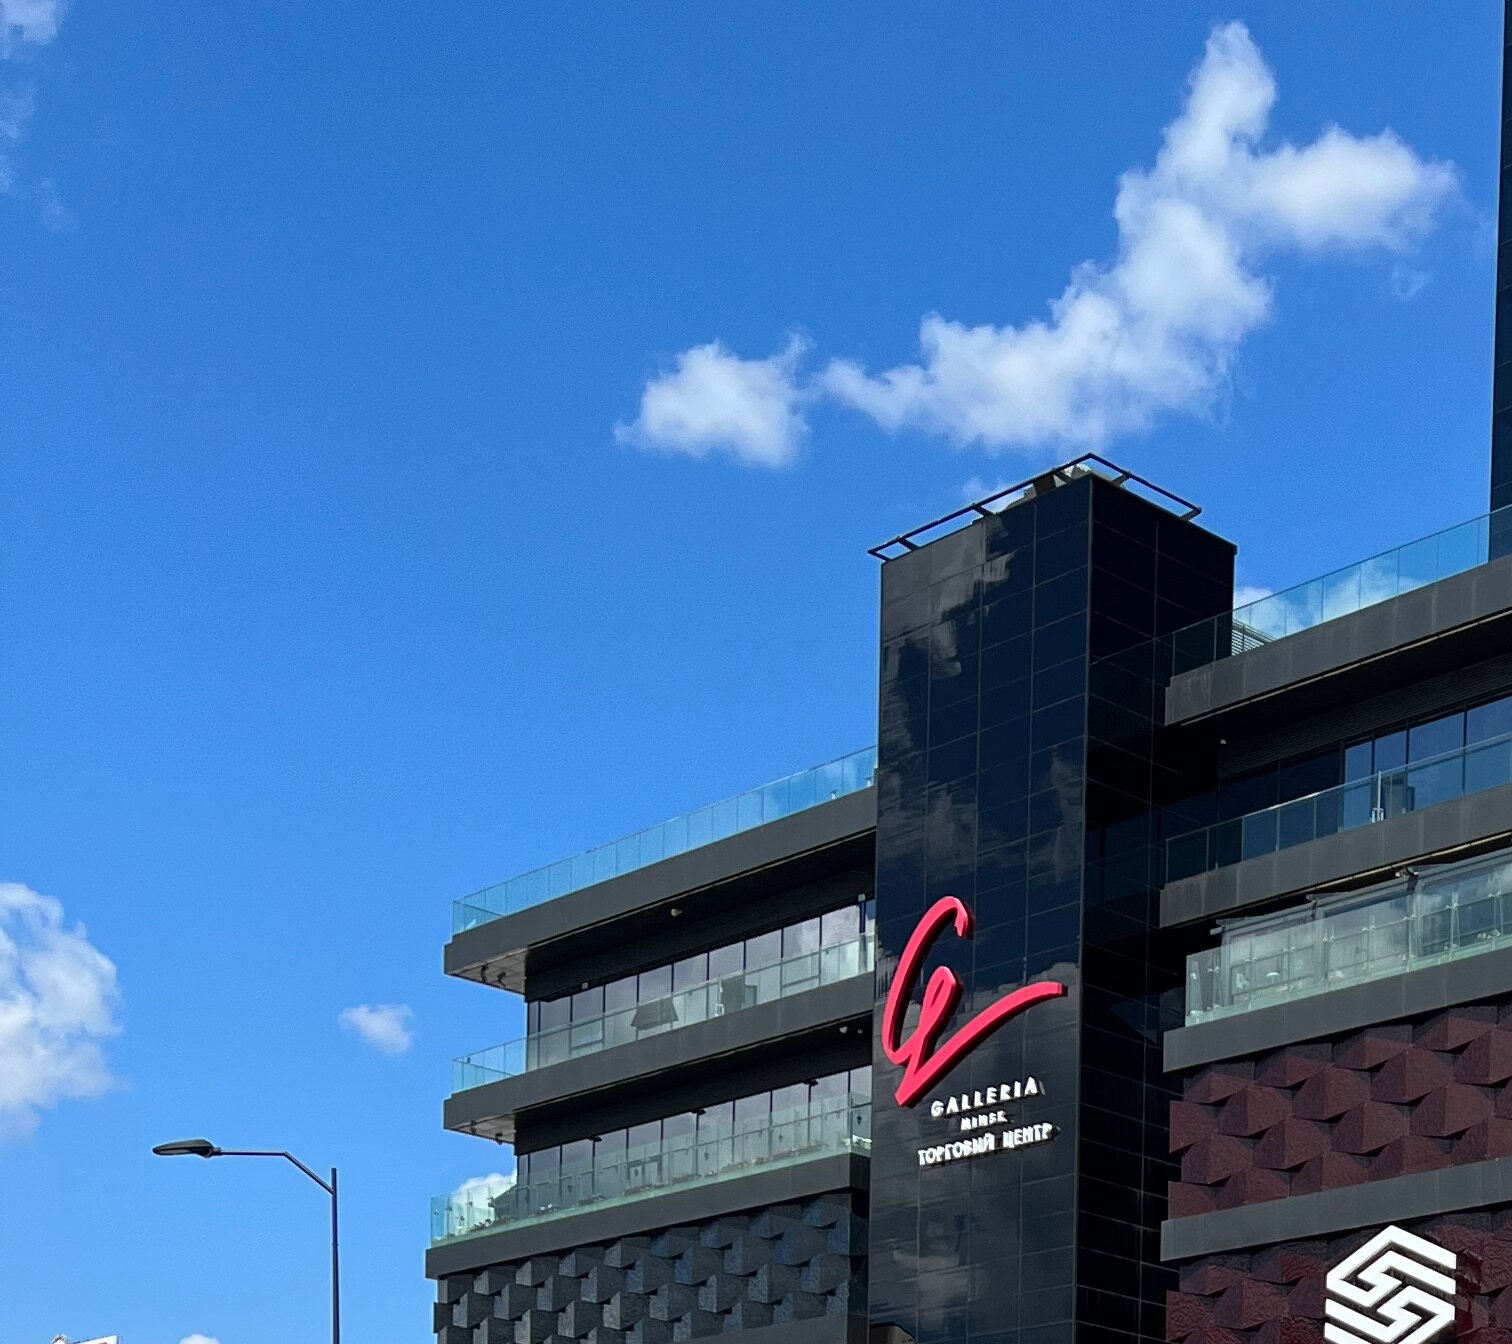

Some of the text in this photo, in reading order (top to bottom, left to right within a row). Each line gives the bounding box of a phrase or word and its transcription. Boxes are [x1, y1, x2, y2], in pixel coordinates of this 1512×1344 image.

[930, 1076, 1038, 1117] GALLERIA
[960, 1110, 1008, 1131] MINSK
[917, 1122, 1053, 1166] ТОРГОВЫЙ ЦЕНТР
